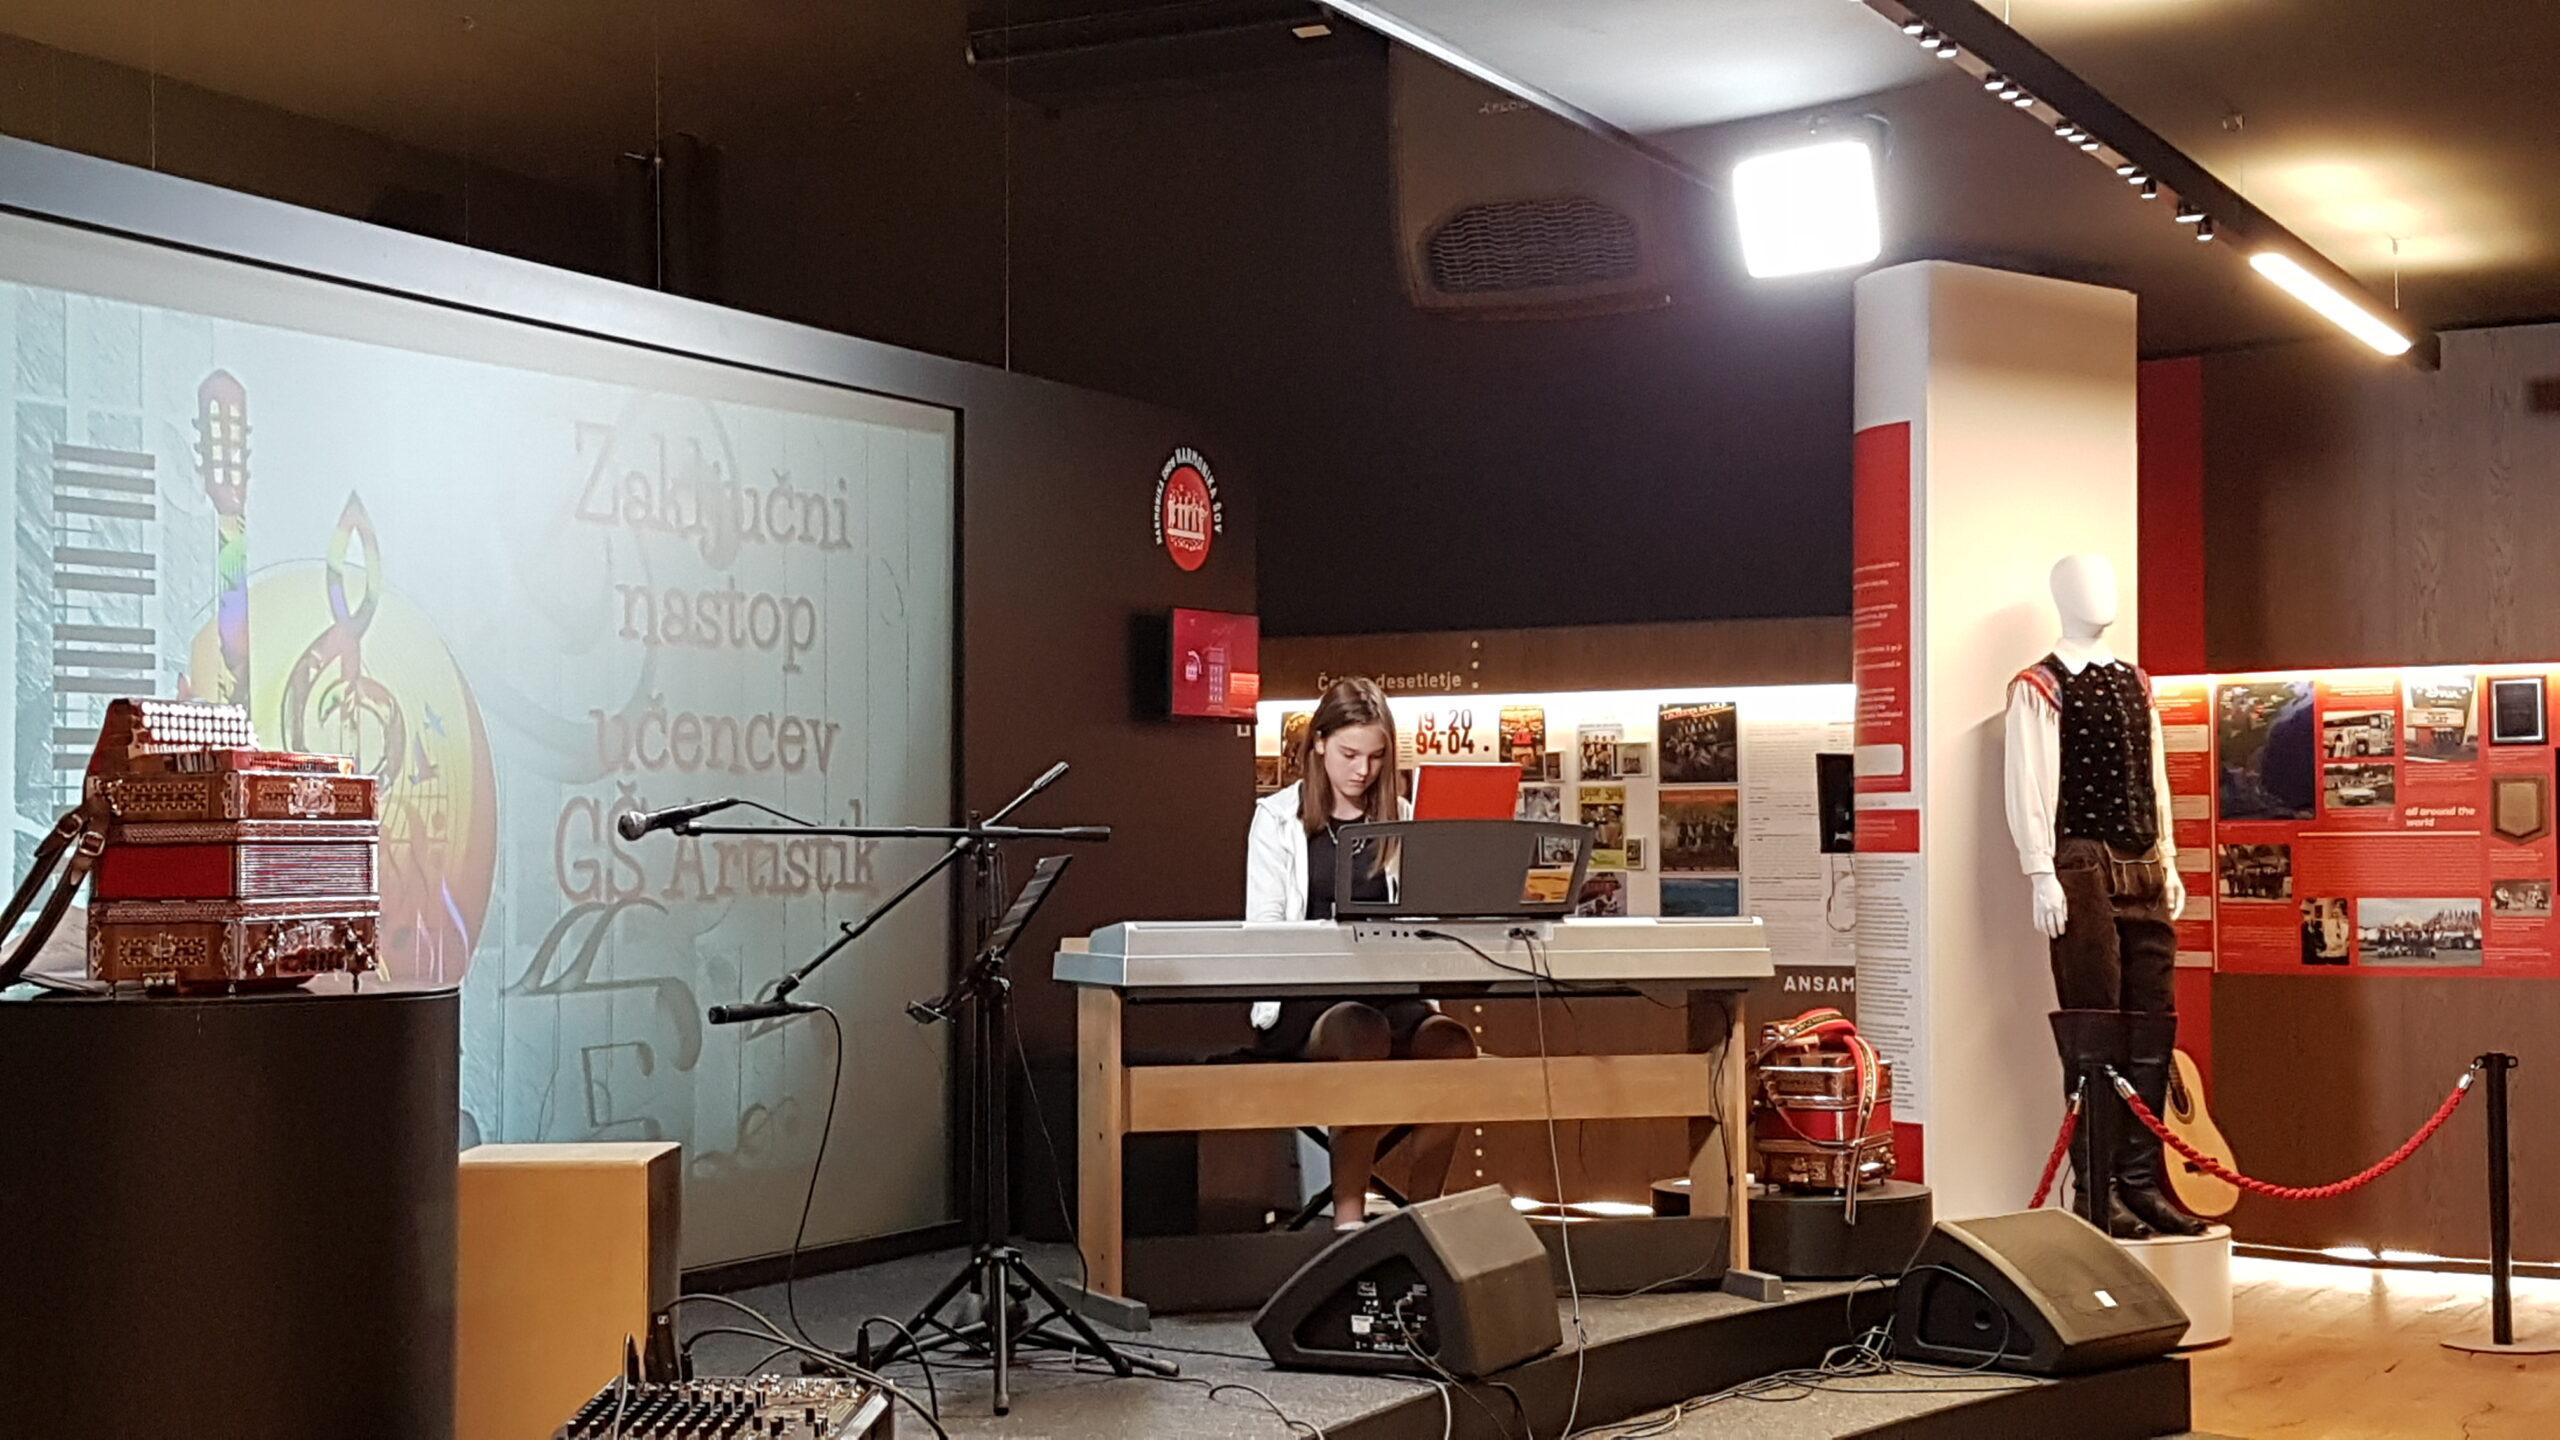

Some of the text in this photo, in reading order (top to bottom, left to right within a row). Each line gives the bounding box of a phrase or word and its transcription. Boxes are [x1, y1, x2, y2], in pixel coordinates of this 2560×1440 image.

[575, 424, 852, 569] Zaključni
[617, 576, 819, 673] nastop
[1377, 672, 1461, 690] desetletje
[1448, 709, 1473, 731] 20
[589, 694, 840, 774] učencev
[2419, 806, 2456, 816] around
[2458, 806, 2476, 816] the
[2406, 818, 2435, 827] world
[1783, 975, 1855, 993] ANSAM
